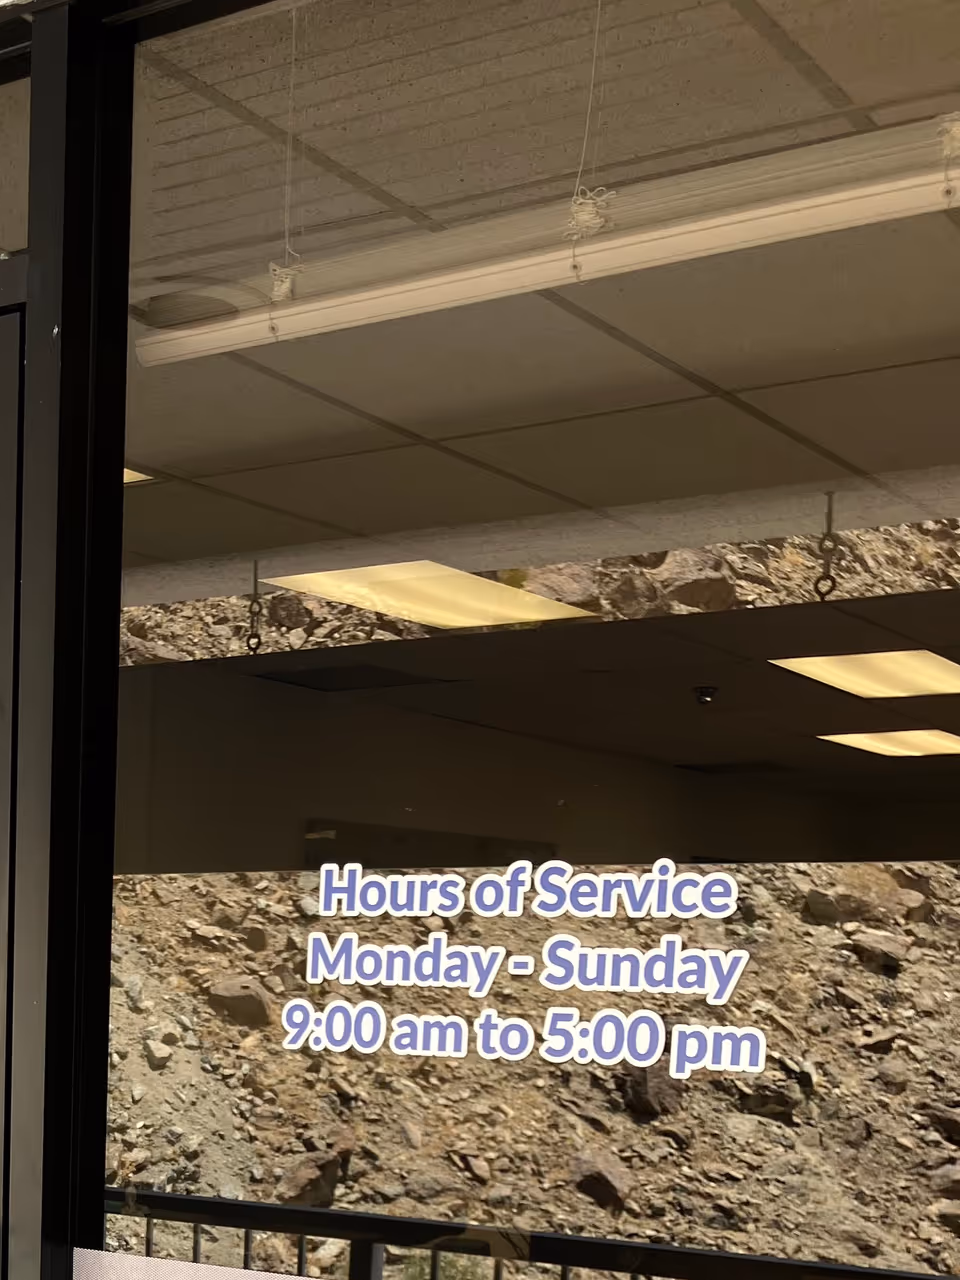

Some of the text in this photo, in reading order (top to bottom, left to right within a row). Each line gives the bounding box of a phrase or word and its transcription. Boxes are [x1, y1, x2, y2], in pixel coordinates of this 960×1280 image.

[319, 857, 739, 918] Hours of Service
[306, 931, 749, 1006] Monday - Sunday
[282, 997, 765, 1079] 9:00 am to 5:00 pm
